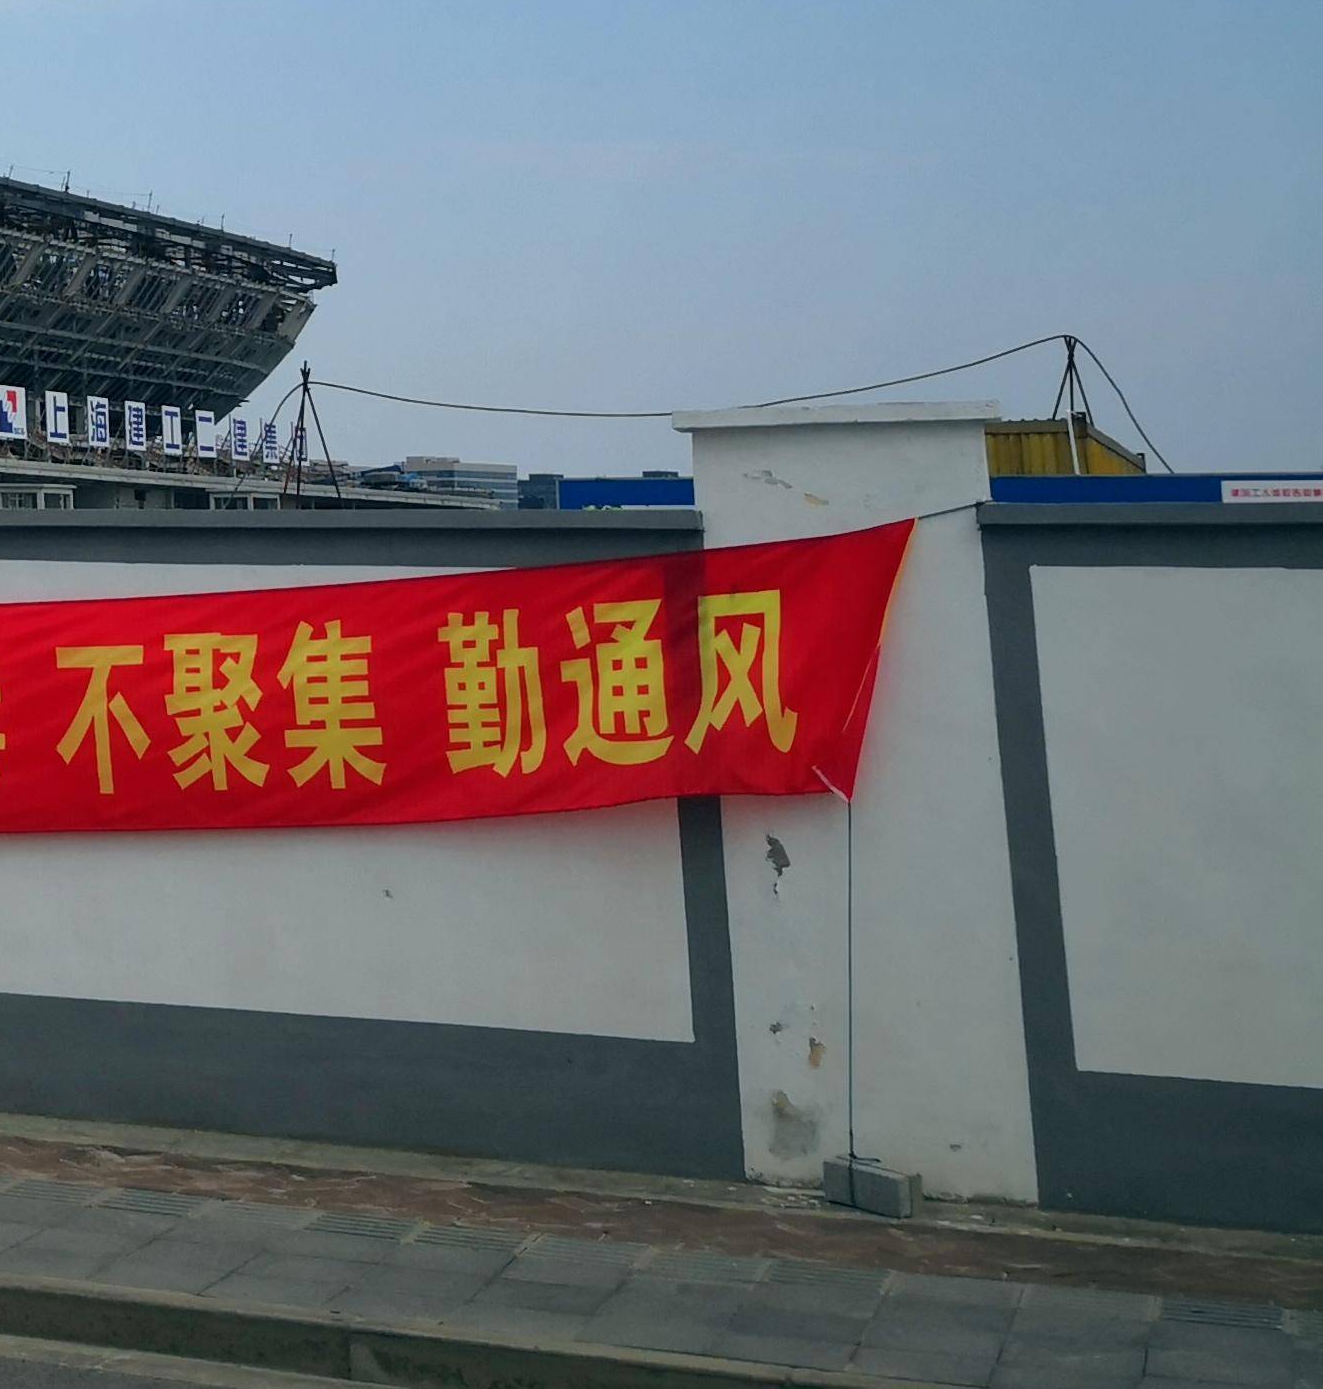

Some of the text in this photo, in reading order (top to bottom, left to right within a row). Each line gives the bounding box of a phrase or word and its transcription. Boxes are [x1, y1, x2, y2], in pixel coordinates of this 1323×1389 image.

[57, 621, 386, 792] 不聚集
[438, 589, 798, 777] 勤通风
